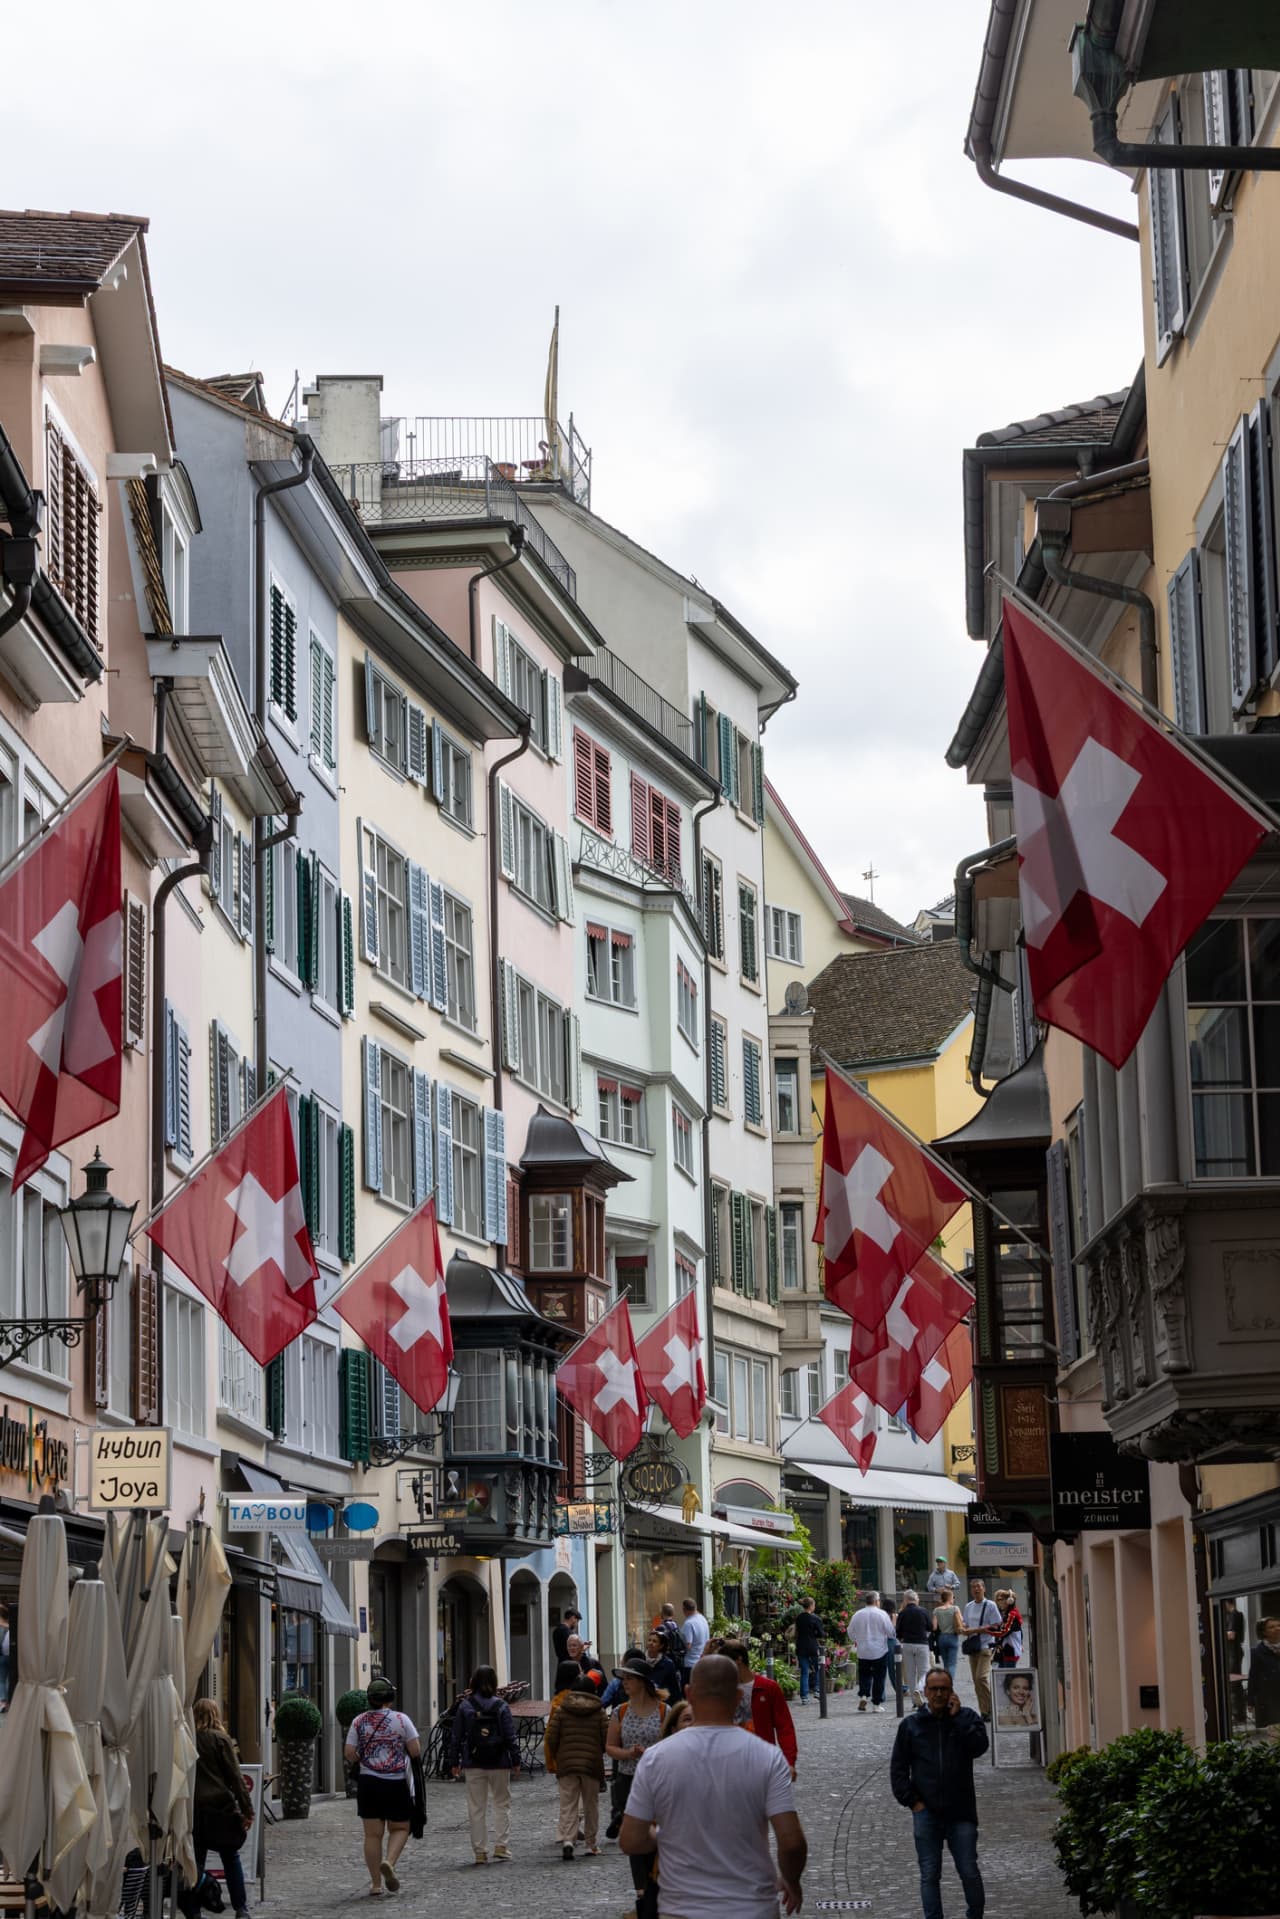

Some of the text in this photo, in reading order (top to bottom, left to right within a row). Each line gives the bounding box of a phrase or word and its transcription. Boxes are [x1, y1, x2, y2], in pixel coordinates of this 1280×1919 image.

[0, 1404, 68, 1497] bun Joya
[97, 1436, 161, 1459] kybun
[100, 1477, 158, 1503] Joya
[634, 1464, 675, 1493] ROECKL
[1057, 1488, 1144, 1504] meister
[1083, 1514, 1119, 1523] ZÜRICH
